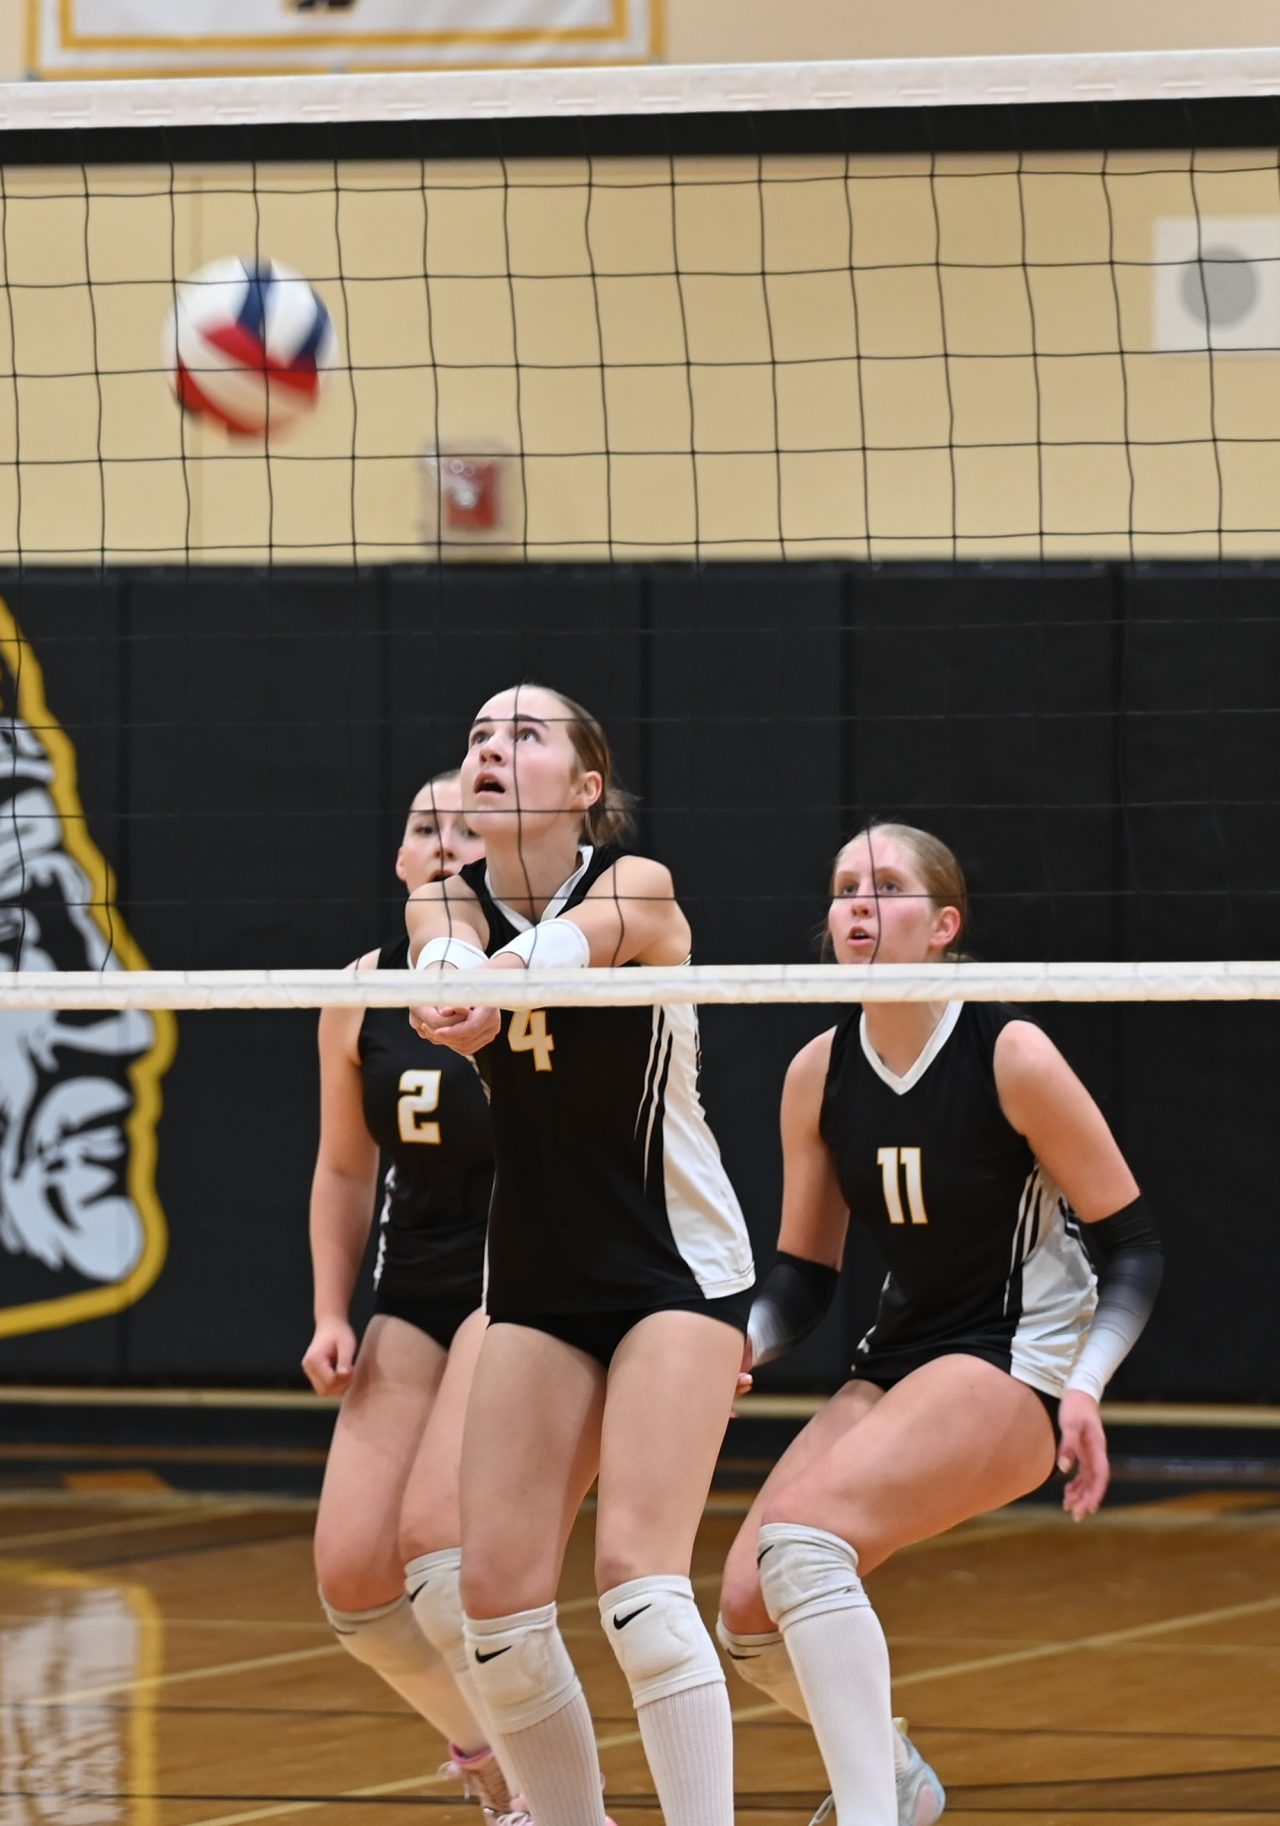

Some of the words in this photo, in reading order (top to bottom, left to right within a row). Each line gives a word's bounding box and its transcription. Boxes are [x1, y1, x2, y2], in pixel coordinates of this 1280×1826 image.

[507, 1006, 554, 1072] 4
[397, 1069, 442, 1145] 2
[877, 1146, 928, 1225] 11
